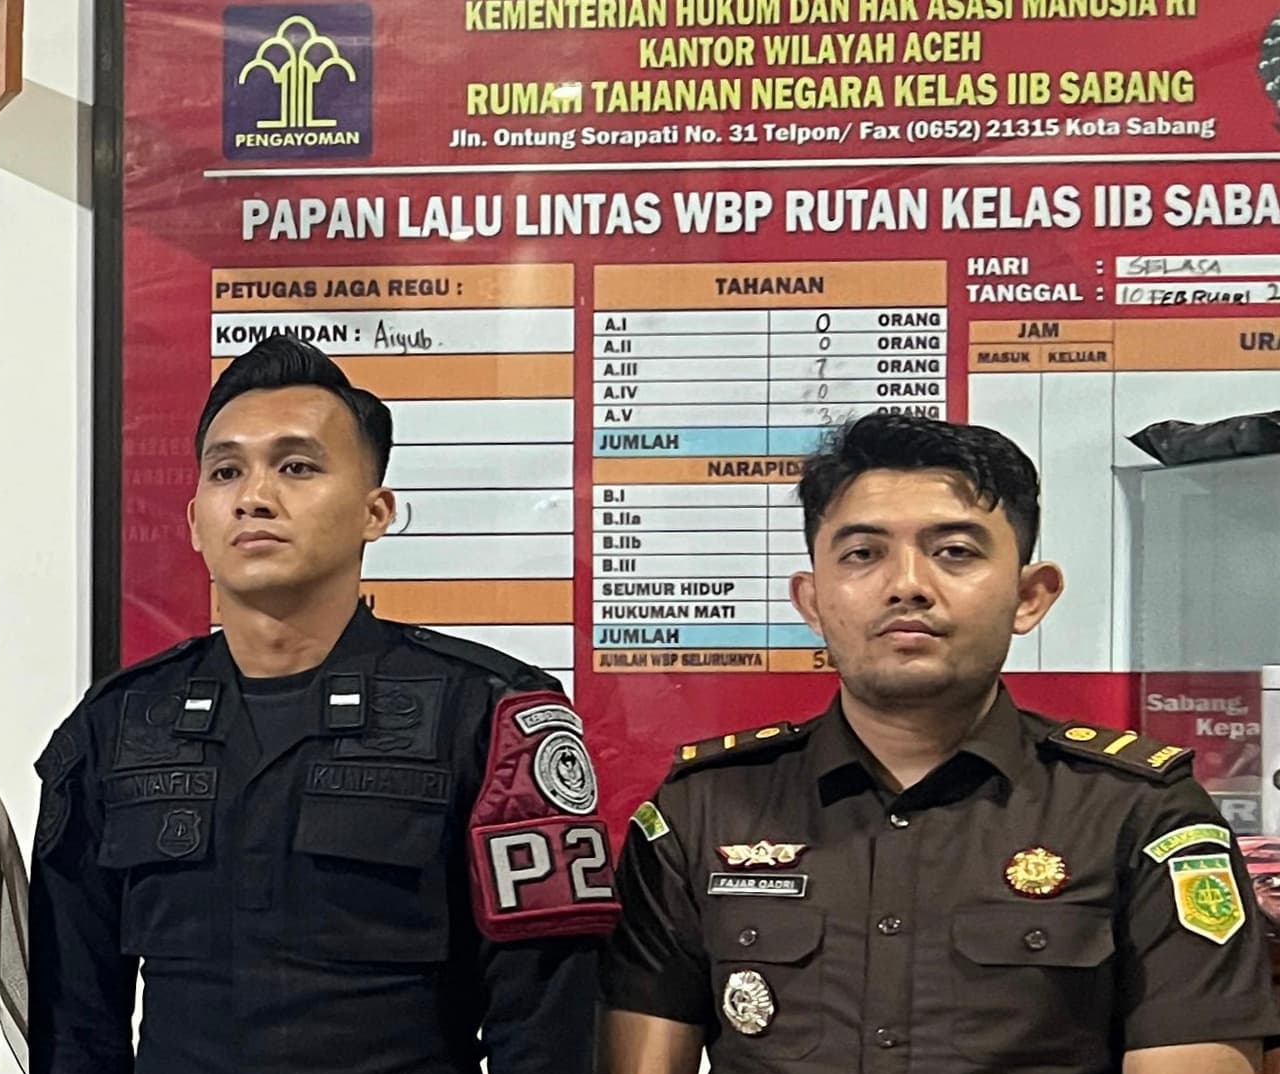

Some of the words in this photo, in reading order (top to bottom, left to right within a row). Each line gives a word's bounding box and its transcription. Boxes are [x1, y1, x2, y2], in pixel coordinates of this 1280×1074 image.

[465, 0, 667, 31] KEMENTERIAN
[675, 0, 780, 26] HUKUM
[789, 0, 851, 25] DAN
[858, 0, 920, 22] HAK
[926, 0, 1014, 21] ASASI
[1022, 0, 1157, 18] MANUSIA
[640, 36, 755, 68] KANTOR
[764, 34, 896, 66] WILAYAH
[903, 31, 982, 63] ACEH
[467, 82, 582, 115] RUMAH
[591, 79, 742, 112] TAHANAN
[751, 76, 883, 109] NEGARA
[894, 74, 998, 107] KELAS
[1007, 72, 1051, 105] IIB
[1059, 70, 1195, 103] SABANG
[235, 131, 360, 148] PENGAYOMAN
[449, 129, 487, 148] Jln.
[493, 127, 575, 149] Ontung
[581, 125, 678, 147] Sorapati
[685, 124, 722, 144] No.
[729, 123, 757, 142] 31
[763, 121, 851, 144] Telpon/
[860, 121, 899, 140] Fax
[906, 118, 981, 142] (0652)
[986, 117, 1059, 137] 21315
[1066, 117, 1120, 136] Kota
[1126, 115, 1215, 139] Sabang
[242, 197, 385, 241] PAPAN
[399, 194, 502, 239] LALU
[515, 192, 663, 237] LINTAS
[673, 189, 773, 234] WBP
[785, 187, 928, 232] RUTAN
[942, 185, 1081, 230] KELAS
[1094, 184, 1153, 229] IIB
[1163, 183, 1280, 227] SABA
[967, 257, 1028, 275] HARI
[216, 282, 317, 299] PETUGAS
[324, 280, 381, 298] JAGA
[388, 279, 449, 296] REGU
[716, 276, 824, 295] TAHANAN
[966, 283, 1084, 302] TANGGAL
[605, 317, 627, 331] A.I
[816, 313, 831, 333] 0
[878, 313, 940, 327] ORANG
[216, 325, 347, 344] KOMANDAN
[1017, 323, 1059, 339] JAM
[819, 336, 831, 351] 0
[877, 336, 940, 350] ORANG
[977, 352, 1031, 363] MASUK
[1048, 351, 1107, 363] KELUAR
[877, 359, 939, 373] ORANG
[603, 385, 637, 400] A.IV
[876, 382, 939, 396] ORANG
[603, 408, 632, 423] A.V
[600, 434, 679, 450] JUMLAH
[603, 489, 625, 502] B.I
[602, 583, 675, 596] SEUMUR
[680, 582, 735, 596] HIDUP
[602, 606, 689, 619] HUKUMAN
[694, 605, 736, 618] MATI
[599, 628, 680, 644] JUMLAH
[1146, 693, 1249, 716] Sabang,
[489, 828, 613, 909] P2
